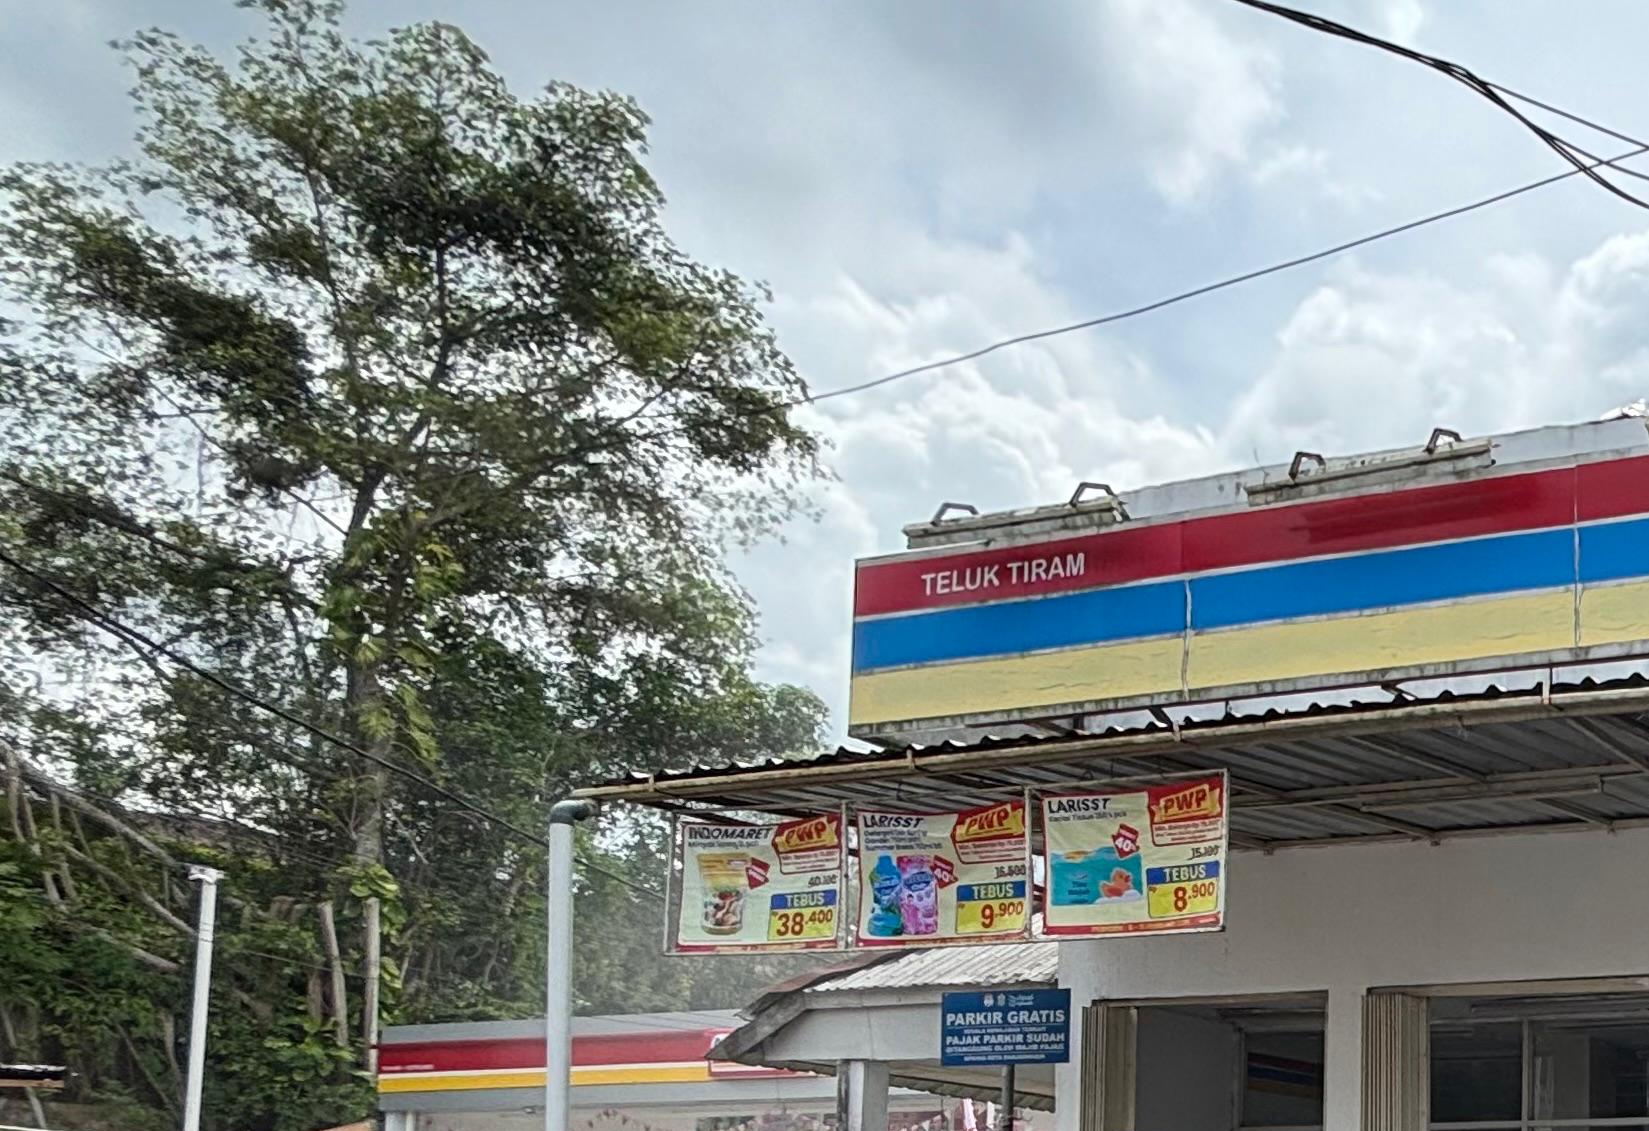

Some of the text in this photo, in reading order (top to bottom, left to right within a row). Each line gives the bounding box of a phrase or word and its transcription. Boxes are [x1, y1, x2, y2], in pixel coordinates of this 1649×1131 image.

[921, 552, 1085, 596] TELUK TIRAM
[1047, 797, 1112, 814] LARISST
[1164, 788, 1208, 813] PWP
[863, 815, 924, 828] LARISST
[965, 807, 1009, 836] PWP
[688, 826, 774, 840] INDOMARET
[785, 820, 828, 845] PWP
[1163, 865, 1207, 881] TEBUS
[972, 882, 1014, 899] TEBUS
[1173, 882, 1215, 912] 8.900
[786, 891, 826, 908] TEBUS
[776, 909, 834, 937] 38.400
[981, 902, 1024, 929] 9.900
[946, 1010, 1065, 1026] PARKIR GRATIS
[946, 1032, 1065, 1045] PAJAK PARKIR SUDAH
